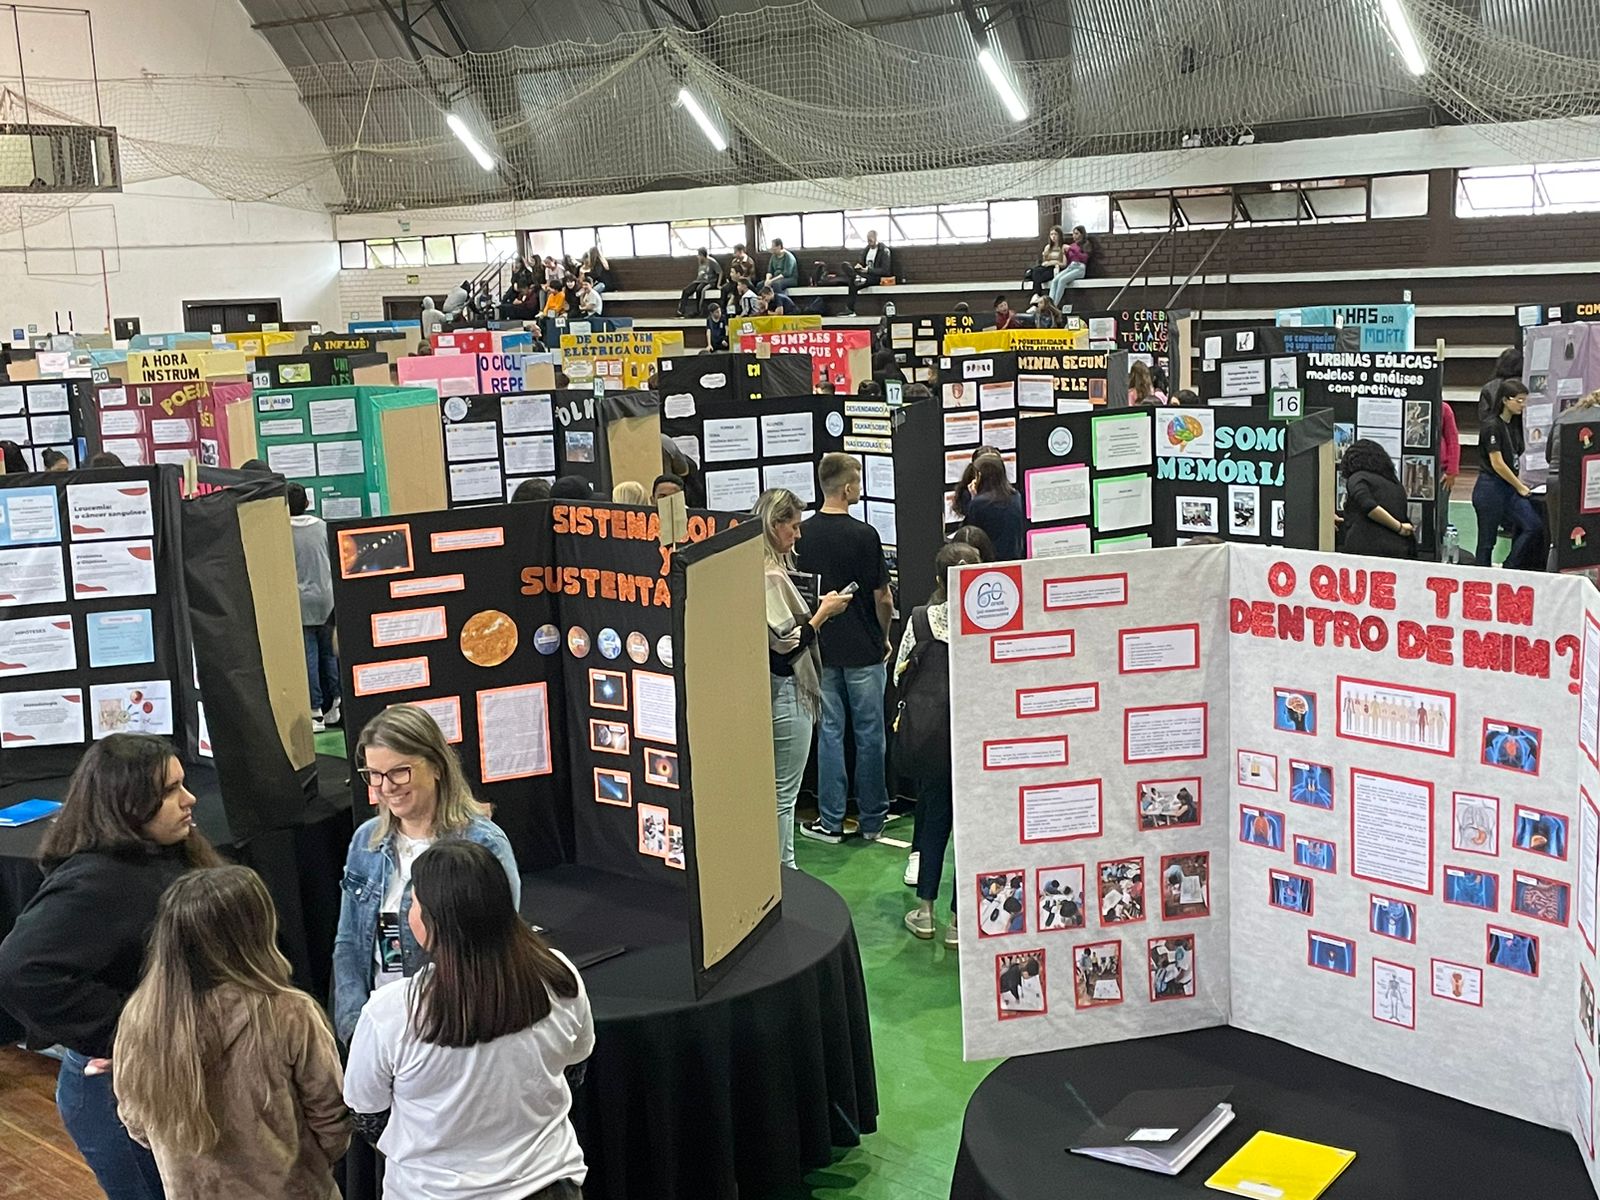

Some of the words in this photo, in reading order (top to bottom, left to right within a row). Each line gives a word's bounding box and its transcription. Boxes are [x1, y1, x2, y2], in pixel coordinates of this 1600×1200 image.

[945, 316, 957, 326] DE
[1121, 311, 1129, 320] O
[1134, 309, 1168, 320] CÉREB
[1069, 319, 1078, 327] 42
[1134, 322, 1140, 331] E
[1143, 322, 1151, 331] A
[576, 335, 591, 344] DE
[596, 333, 629, 344] ONDE
[632, 333, 653, 343] VEM
[771, 332, 830, 345] SIMPLES
[1121, 332, 1143, 342] TEM
[313, 342, 321, 351] A
[325, 338, 370, 350] INFLUÊ
[564, 343, 631, 357] ELÉTRICA
[633, 345, 652, 355] QUE
[142, 356, 150, 368] A
[154, 353, 188, 367] HORA
[480, 357, 489, 371] O
[492, 355, 527, 371] CICL
[1018, 356, 1060, 370] MINHA
[94, 371, 108, 382] 20
[143, 368, 200, 382] INSTRUM
[255, 375, 270, 387] 19
[1306, 369, 1355, 380] modelos
[1360, 371, 1367, 381] e
[1373, 370, 1424, 385] análises
[1053, 378, 1088, 391] PELE
[1327, 384, 1408, 398] comparativas
[889, 387, 900, 399] 17
[1277, 396, 1299, 412] 16
[74, 504, 112, 512] Leucemia:
[81, 511, 107, 519] câncer
[553, 505, 661, 541] SISTEMA
[521, 567, 671, 608] SUSTENTA
[1268, 561, 1297, 597] O
[1310, 564, 1397, 610] QUE
[1426, 577, 1535, 626] TEM
[1230, 598, 1389, 652] DENTRO
[1398, 620, 1455, 666] DE
[1463, 629, 1581, 696] MIM?
